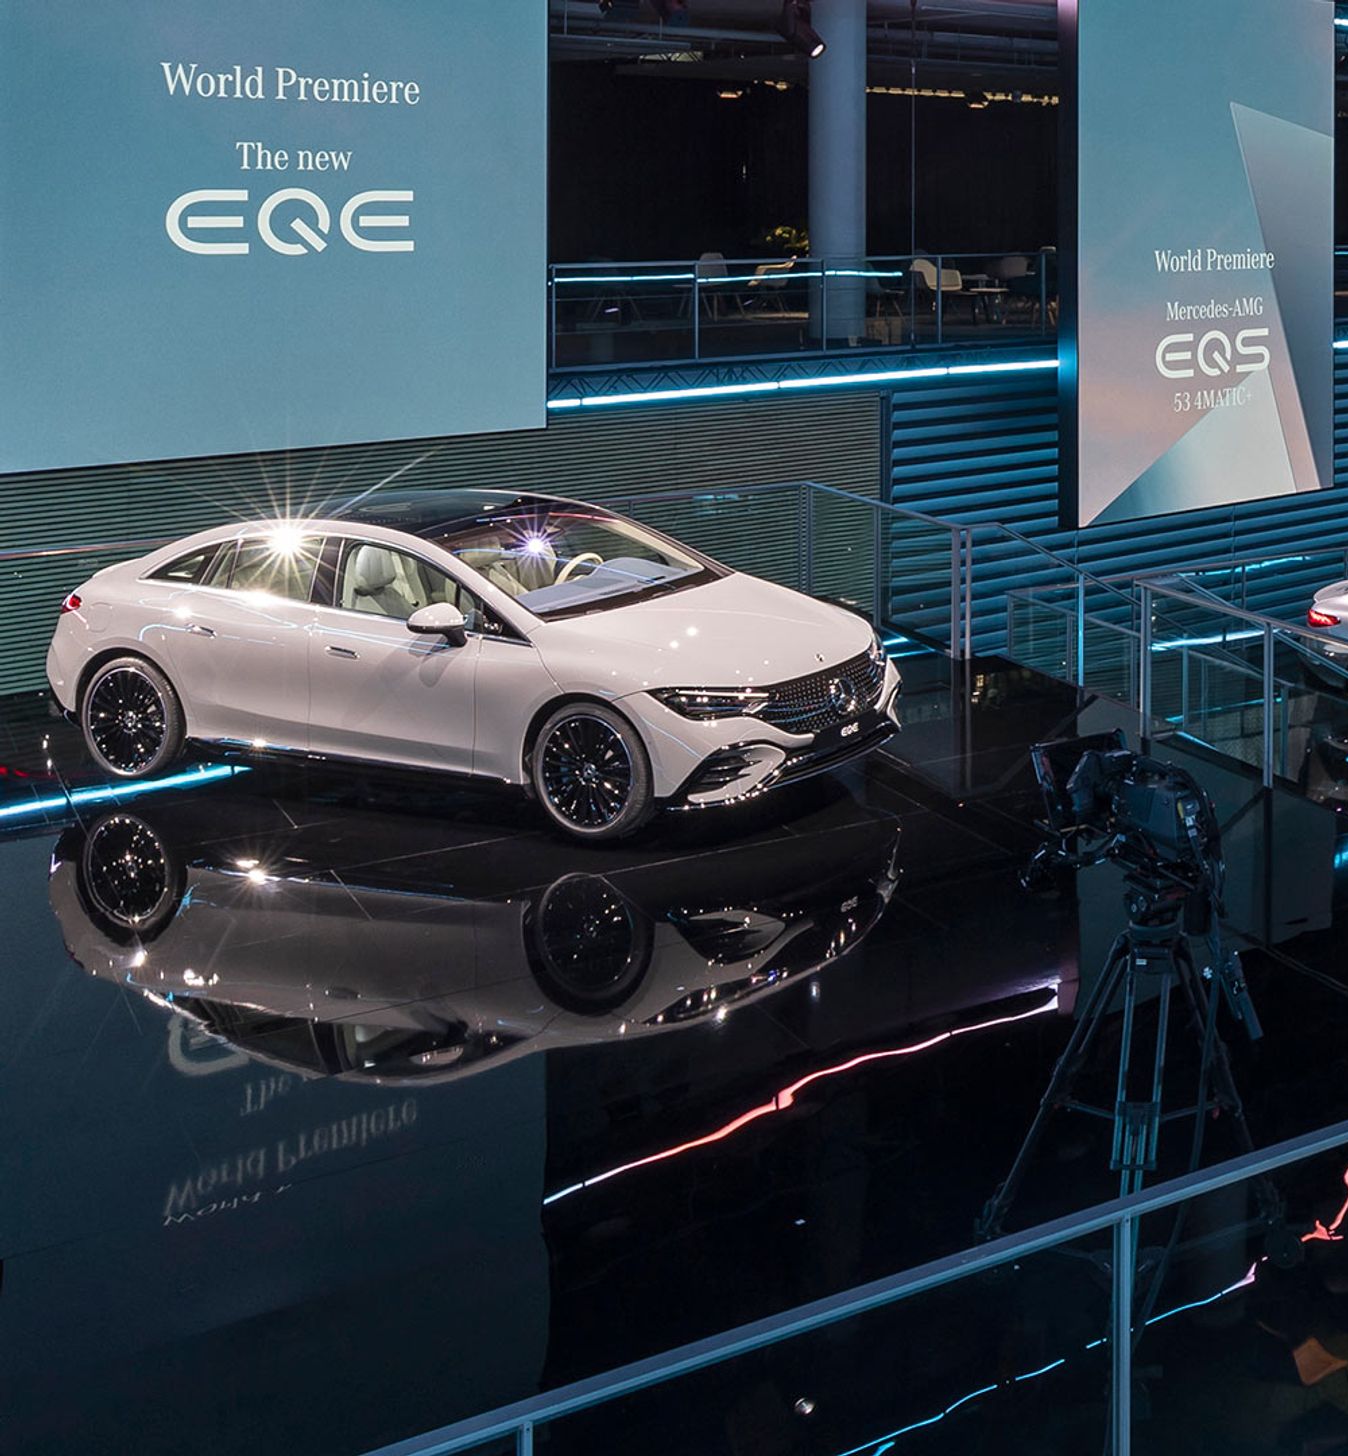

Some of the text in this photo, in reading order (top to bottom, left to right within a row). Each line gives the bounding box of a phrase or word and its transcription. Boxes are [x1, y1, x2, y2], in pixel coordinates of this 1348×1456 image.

[160, 61, 420, 105] World Premiere
[235, 141, 352, 171] The new
[165, 188, 415, 256] EQE
[1154, 248, 1275, 272] World Premiere
[1165, 297, 1264, 321] Mercedes-AMG
[1155, 328, 1270, 379] EQS
[1174, 388, 1252, 412] 53 4MATIC+
